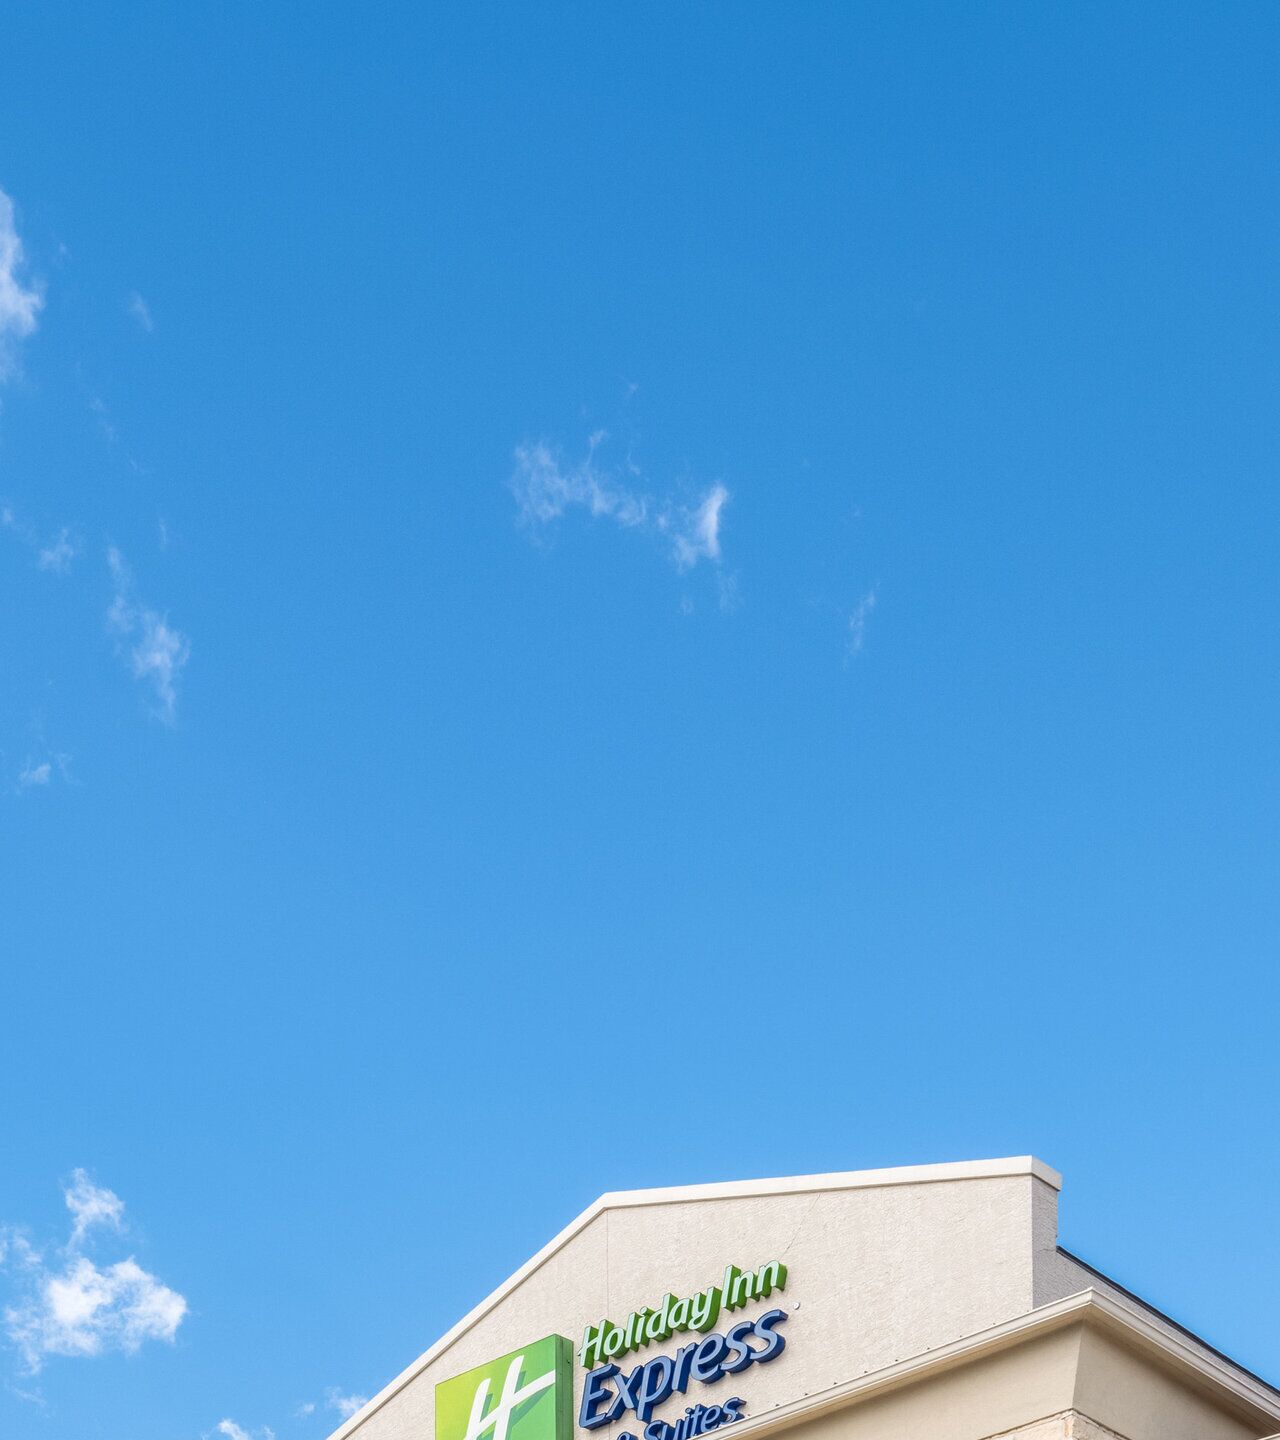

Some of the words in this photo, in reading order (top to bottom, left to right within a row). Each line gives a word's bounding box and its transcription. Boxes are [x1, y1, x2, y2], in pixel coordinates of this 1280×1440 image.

[578, 1286, 721, 1370] Holiday
[721, 1260, 788, 1312] Inn
[579, 1309, 789, 1431] Express
